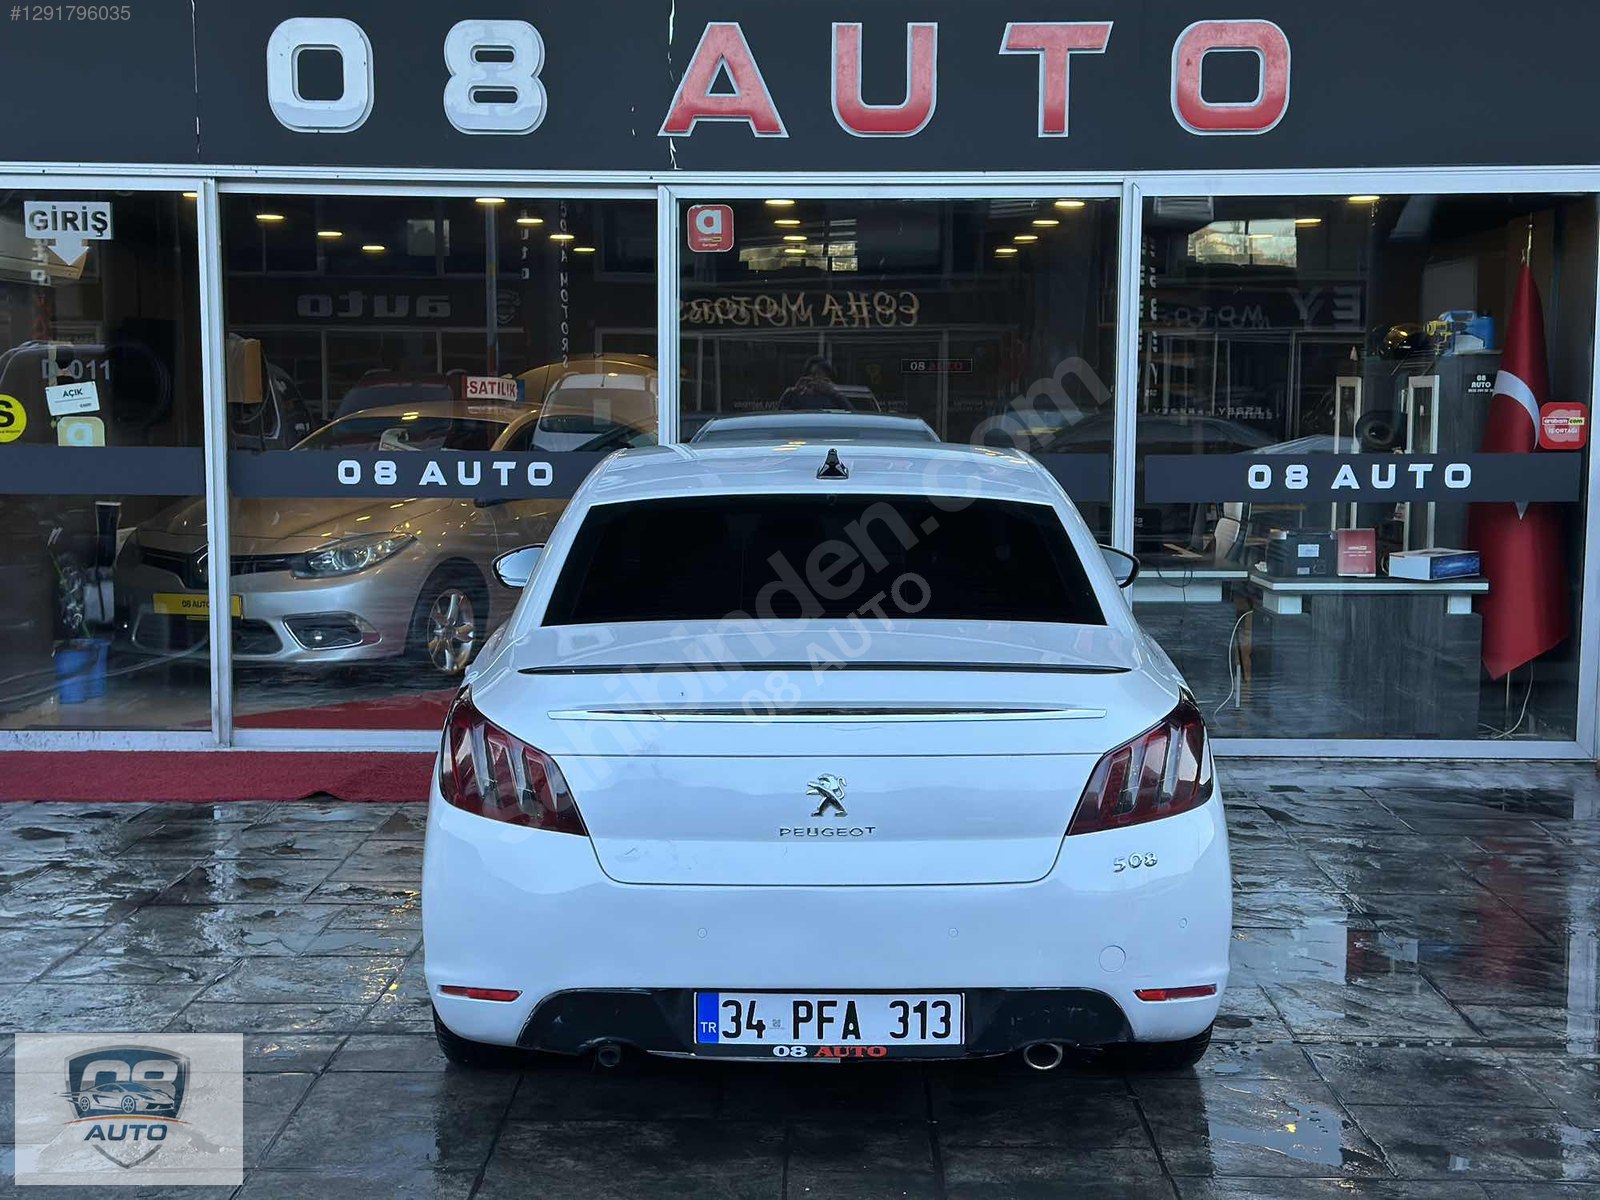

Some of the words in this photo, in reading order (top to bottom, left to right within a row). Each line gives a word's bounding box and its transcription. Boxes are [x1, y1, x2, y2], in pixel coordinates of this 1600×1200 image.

[266, 17, 548, 135] 08
[658, 19, 1291, 138] AUTO
[30, 205, 109, 238] GİRİŞ
[62, 388, 84, 398] AÇIK
[1471, 381, 1492, 389] AUTO
[337, 460, 398, 486] 08
[418, 461, 554, 487] AUTO
[1247, 464, 1309, 490] 08
[1331, 463, 1472, 490] AUTO
[779, 826, 877, 837] PEUGEOT
[1112, 852, 1158, 872] 508
[701, 1021, 717, 1033] TR
[721, 999, 766, 1039] 34
[792, 1000, 861, 1040] PFA
[889, 1000, 952, 1040] 313
[772, 1046, 807, 1057] 08
[814, 1046, 888, 1057] AUTO
